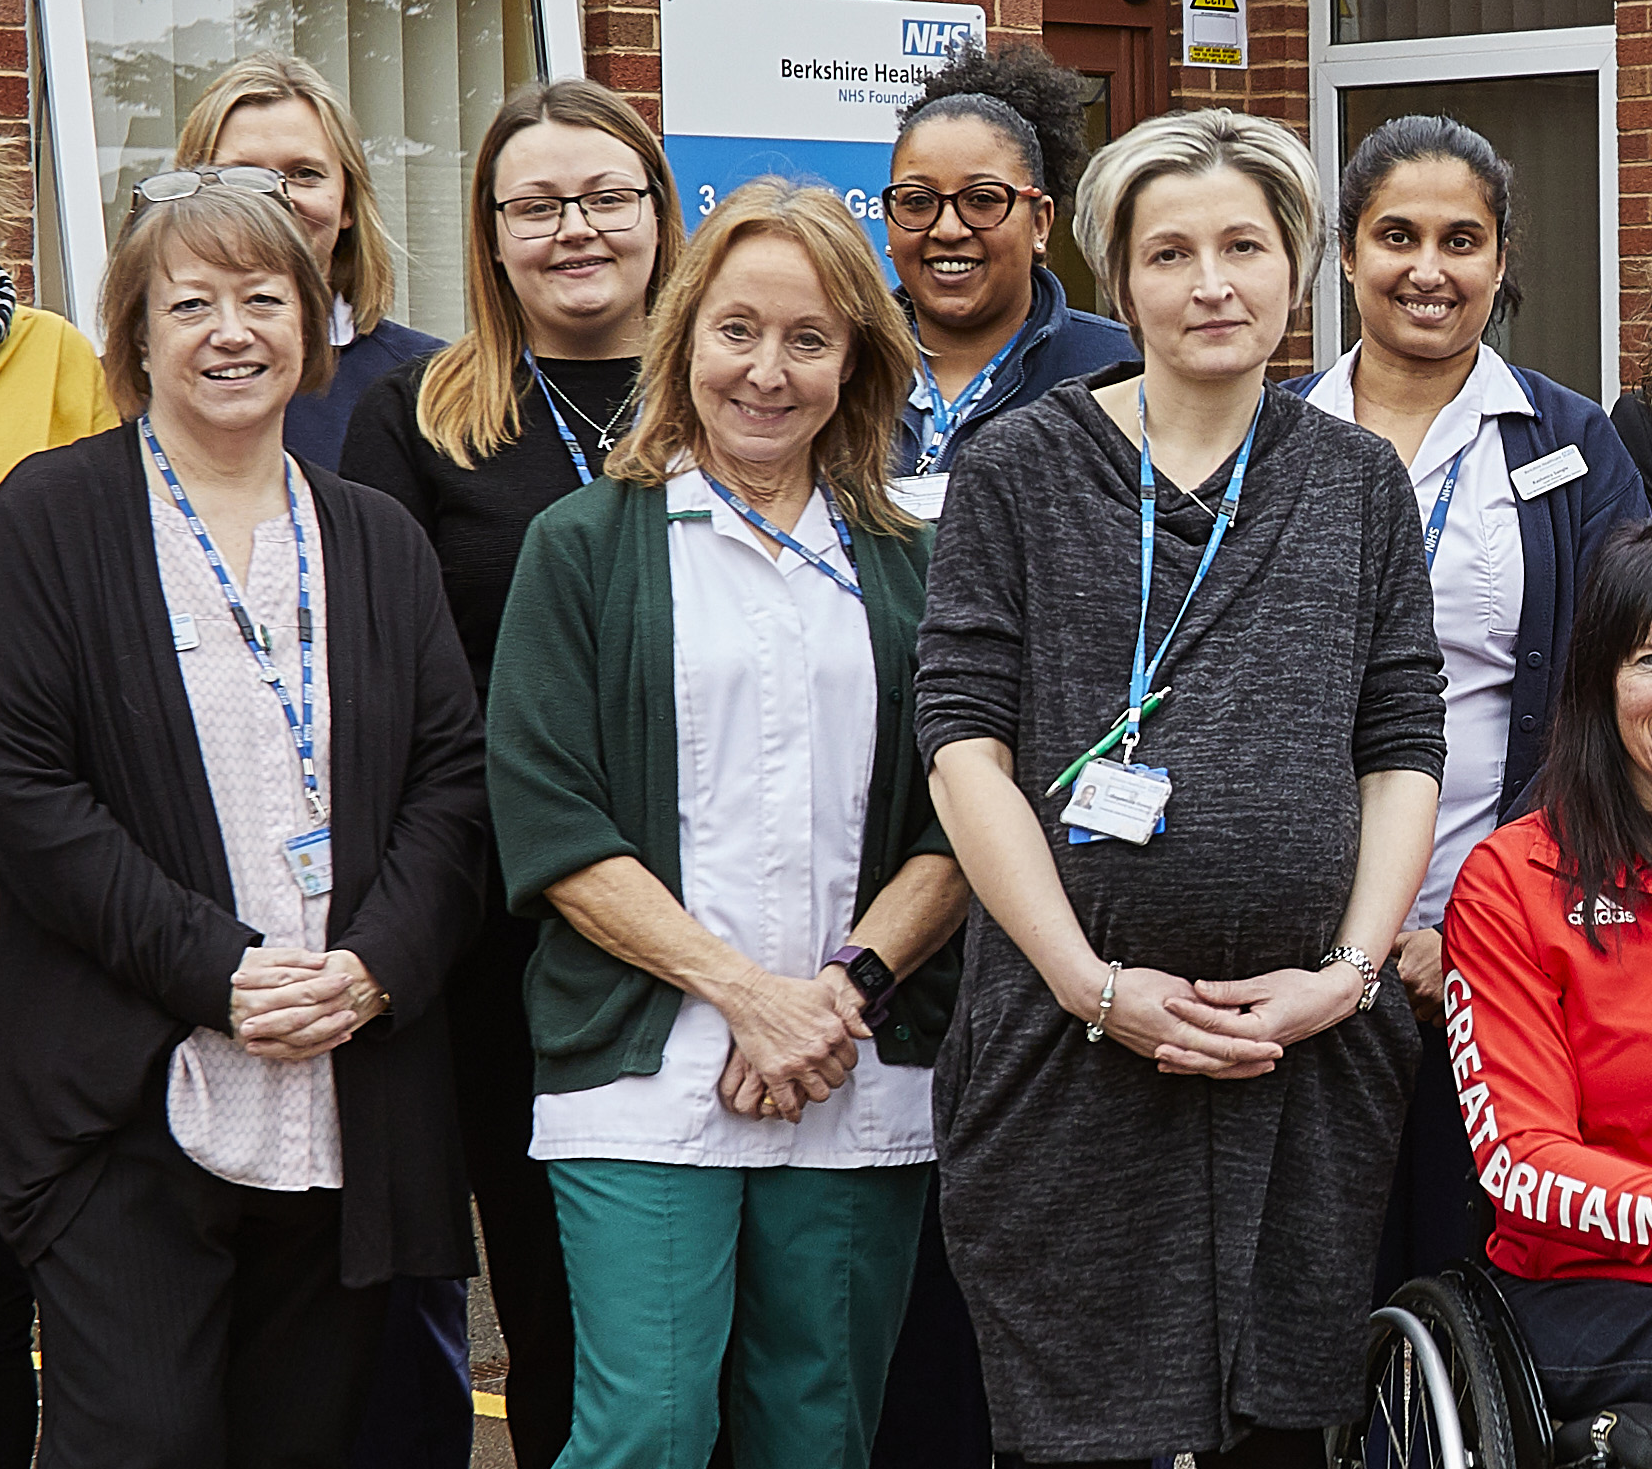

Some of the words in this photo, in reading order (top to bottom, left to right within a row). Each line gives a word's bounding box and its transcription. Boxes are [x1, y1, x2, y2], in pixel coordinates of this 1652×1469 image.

[904, 22, 968, 54] NHS
[781, 59, 868, 81] Berkshire
[838, 88, 865, 103] NHS
[1440, 478, 1454, 502] NHS
[1425, 526, 1440, 553] NHS
[1568, 907, 1636, 926] aidas
[1443, 968, 1498, 1152] GREAT
